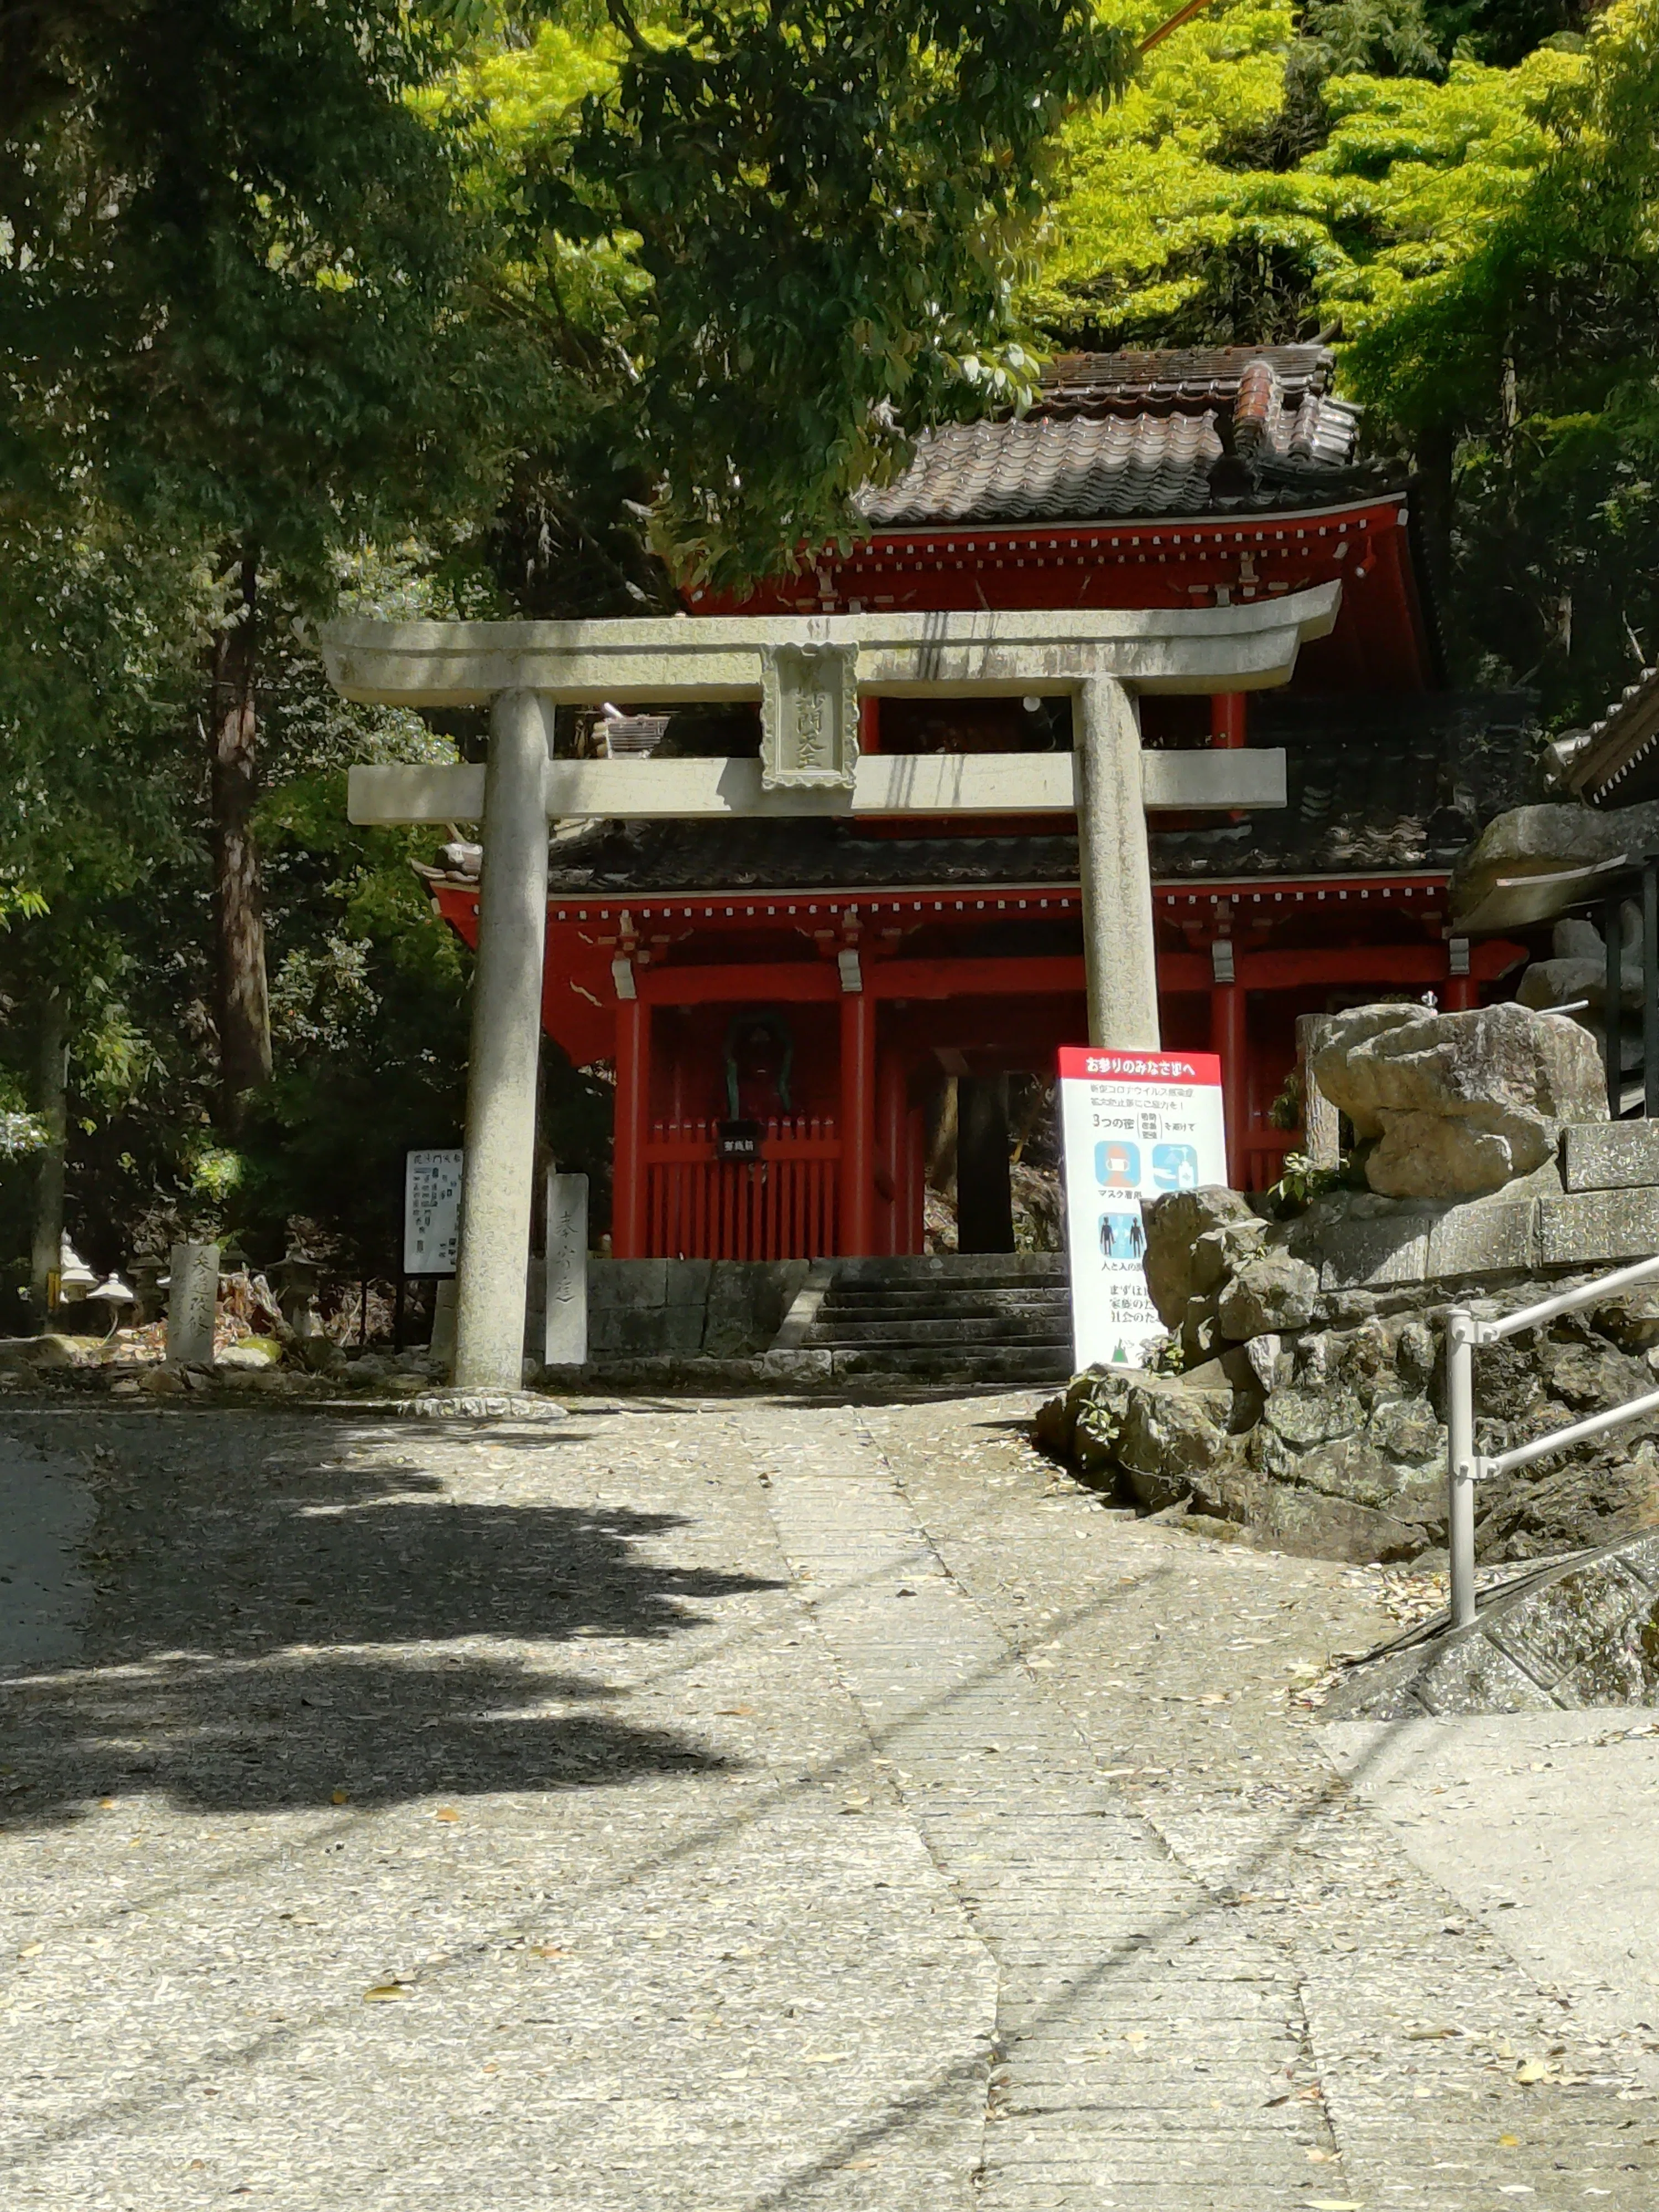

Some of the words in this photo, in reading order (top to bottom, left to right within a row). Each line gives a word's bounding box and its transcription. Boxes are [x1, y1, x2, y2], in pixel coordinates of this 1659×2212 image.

[1086, 1057, 1195, 1077] お参りのみなさまへ
[1110, 1283, 1147, 1296] まずは
